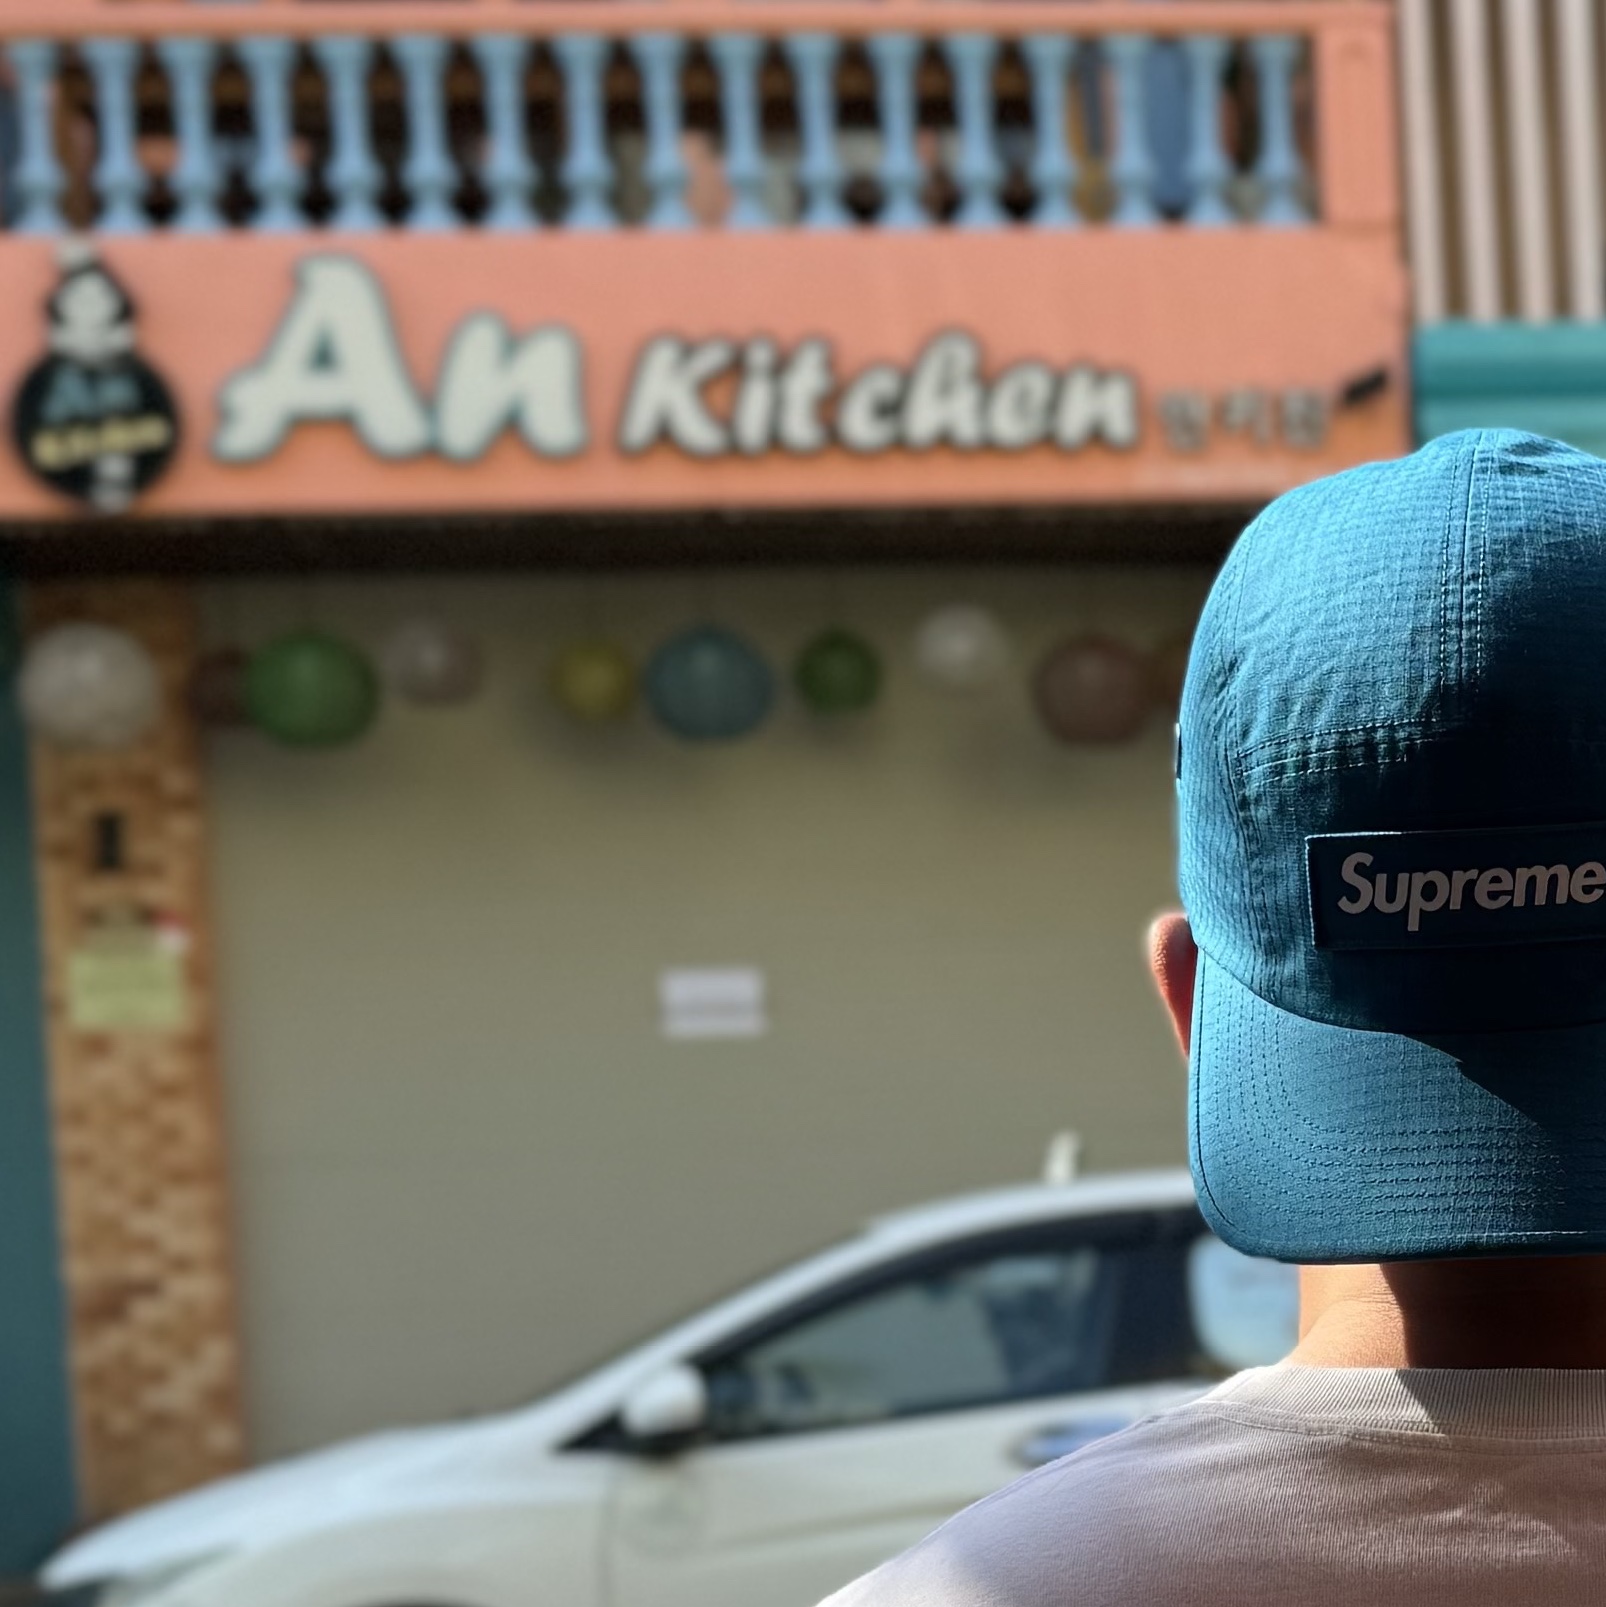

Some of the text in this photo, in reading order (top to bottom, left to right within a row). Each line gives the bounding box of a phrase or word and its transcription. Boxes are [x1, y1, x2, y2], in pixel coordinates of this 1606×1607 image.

[210, 252, 588, 464] An
[616, 330, 1142, 456] Kitchen
[1337, 851, 1606, 931] Supreme
